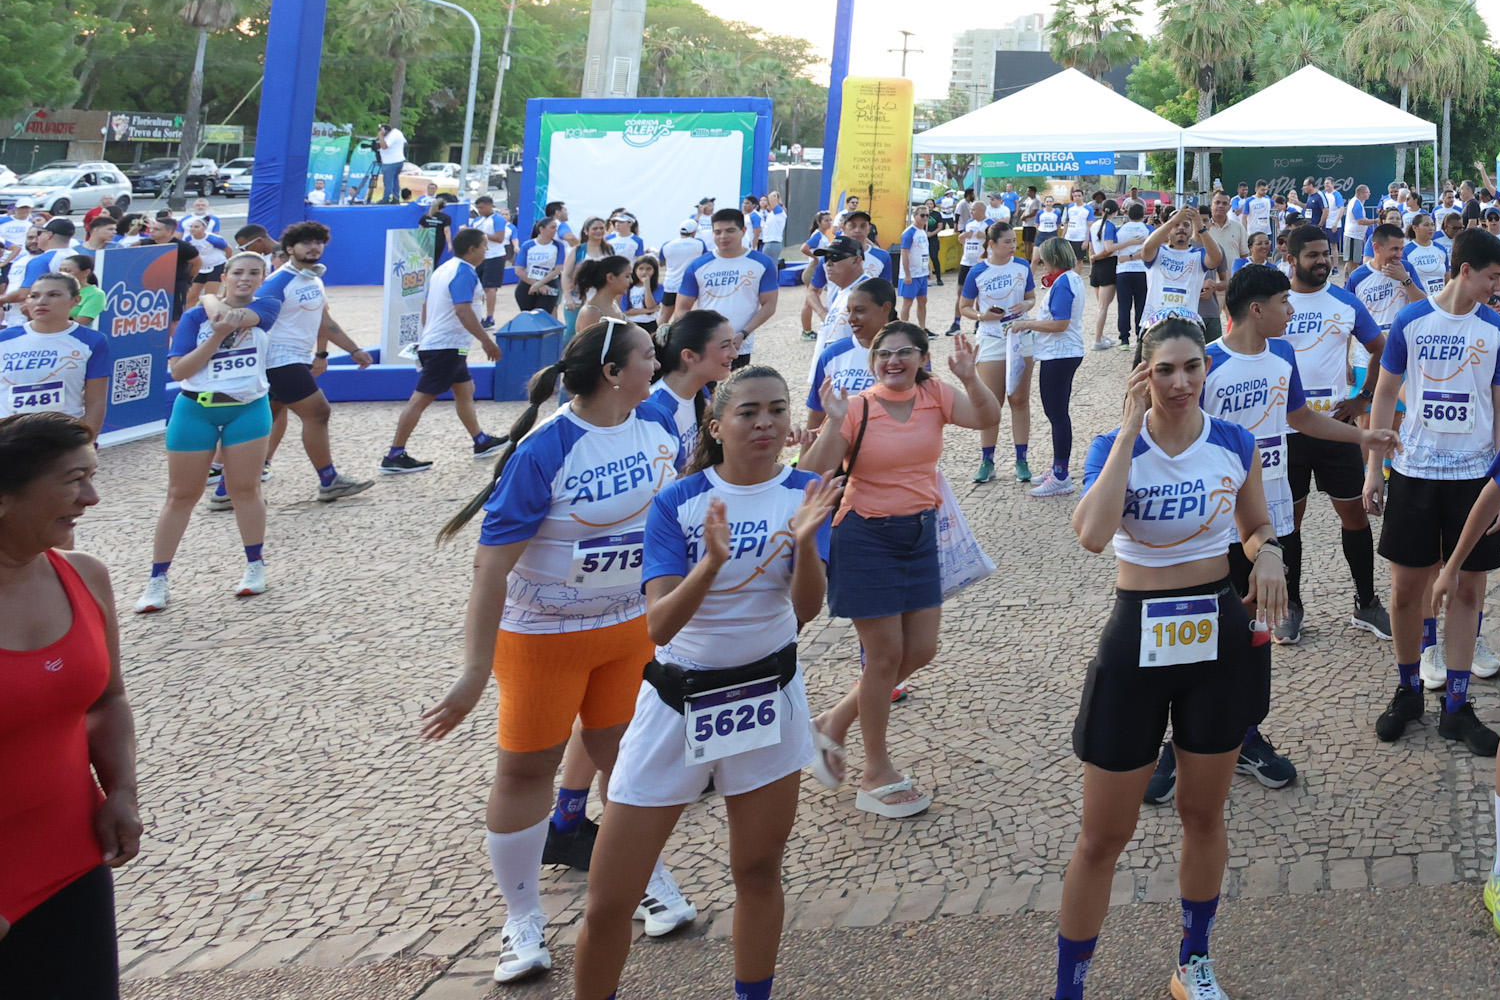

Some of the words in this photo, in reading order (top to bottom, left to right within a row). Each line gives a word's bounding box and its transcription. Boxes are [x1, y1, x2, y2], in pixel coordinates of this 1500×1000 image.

[132, 115, 173, 127] Floricultura
[129, 127, 152, 137] Trevo
[153, 128, 162, 138] da
[163, 128, 183, 138] Sorte
[623, 125, 658, 135] ALEPI
[1021, 152, 1075, 163] ENTREGA
[1016, 162, 1080, 173] MEDALHAS
[1266, 176, 1296, 195] ADA
[1160, 260, 1185, 273] ALEPI
[703, 270, 740, 280] CORRIDA
[984, 273, 1012, 286] CORRIDA
[704, 277, 739, 288] ALEPI
[984, 279, 1012, 292] ALEPI
[1363, 282, 1393, 295] CORRIDA
[1163, 293, 1184, 303] 1031
[1365, 289, 1393, 303] ALEPI
[1292, 312, 1322, 321] RRIDA
[112, 315, 139, 337] FM
[1285, 321, 1322, 335] LEPI
[1415, 334, 1466, 346] CORRIDA
[3, 350, 58, 360] CORRIDA
[1418, 345, 1465, 361] ALEPI
[2, 357, 58, 373] ALEPI
[213, 356, 257, 373] 5360
[1217, 378, 1268, 398] CORRIDA
[13, 390, 60, 409] 5481
[1220, 390, 1268, 416] ALEPI
[1306, 400, 1331, 412] 064
[1423, 404, 1468, 422] 5603
[1261, 449, 1281, 469] 23
[565, 450, 649, 492] CORRIDA
[570, 464, 655, 507] ALEPI
[1122, 494, 1206, 521] ALEPI
[581, 548, 643, 573] 5713
[1152, 618, 1213, 648] 1109
[694, 699, 776, 742] 5626
